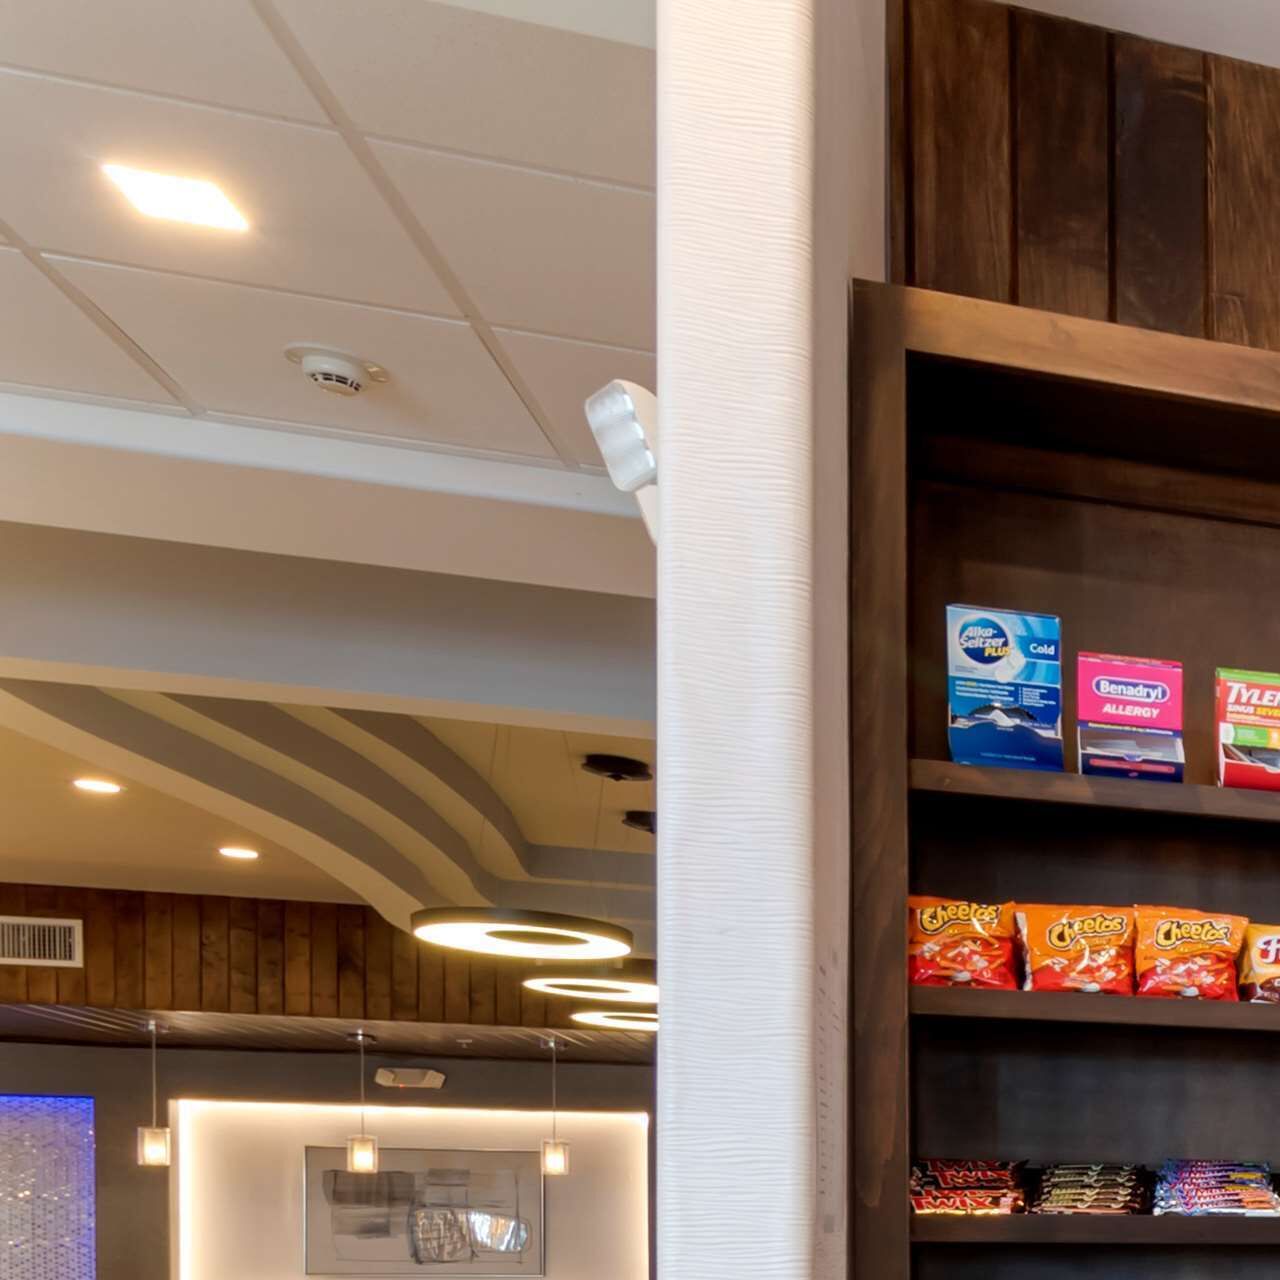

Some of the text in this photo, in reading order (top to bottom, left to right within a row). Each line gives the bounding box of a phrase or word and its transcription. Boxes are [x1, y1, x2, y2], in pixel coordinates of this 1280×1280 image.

[960, 634, 1006, 651] Seltzer
[1029, 643, 1056, 656] Cold
[1099, 679, 1164, 703] Benadryl
[1102, 702, 1160, 719] ALLERGY
[920, 902, 998, 933] Cheetos
[1049, 915, 1126, 948] Cheetos
[1156, 920, 1230, 948] Cheetos
[911, 1196, 993, 1211] TWIX
